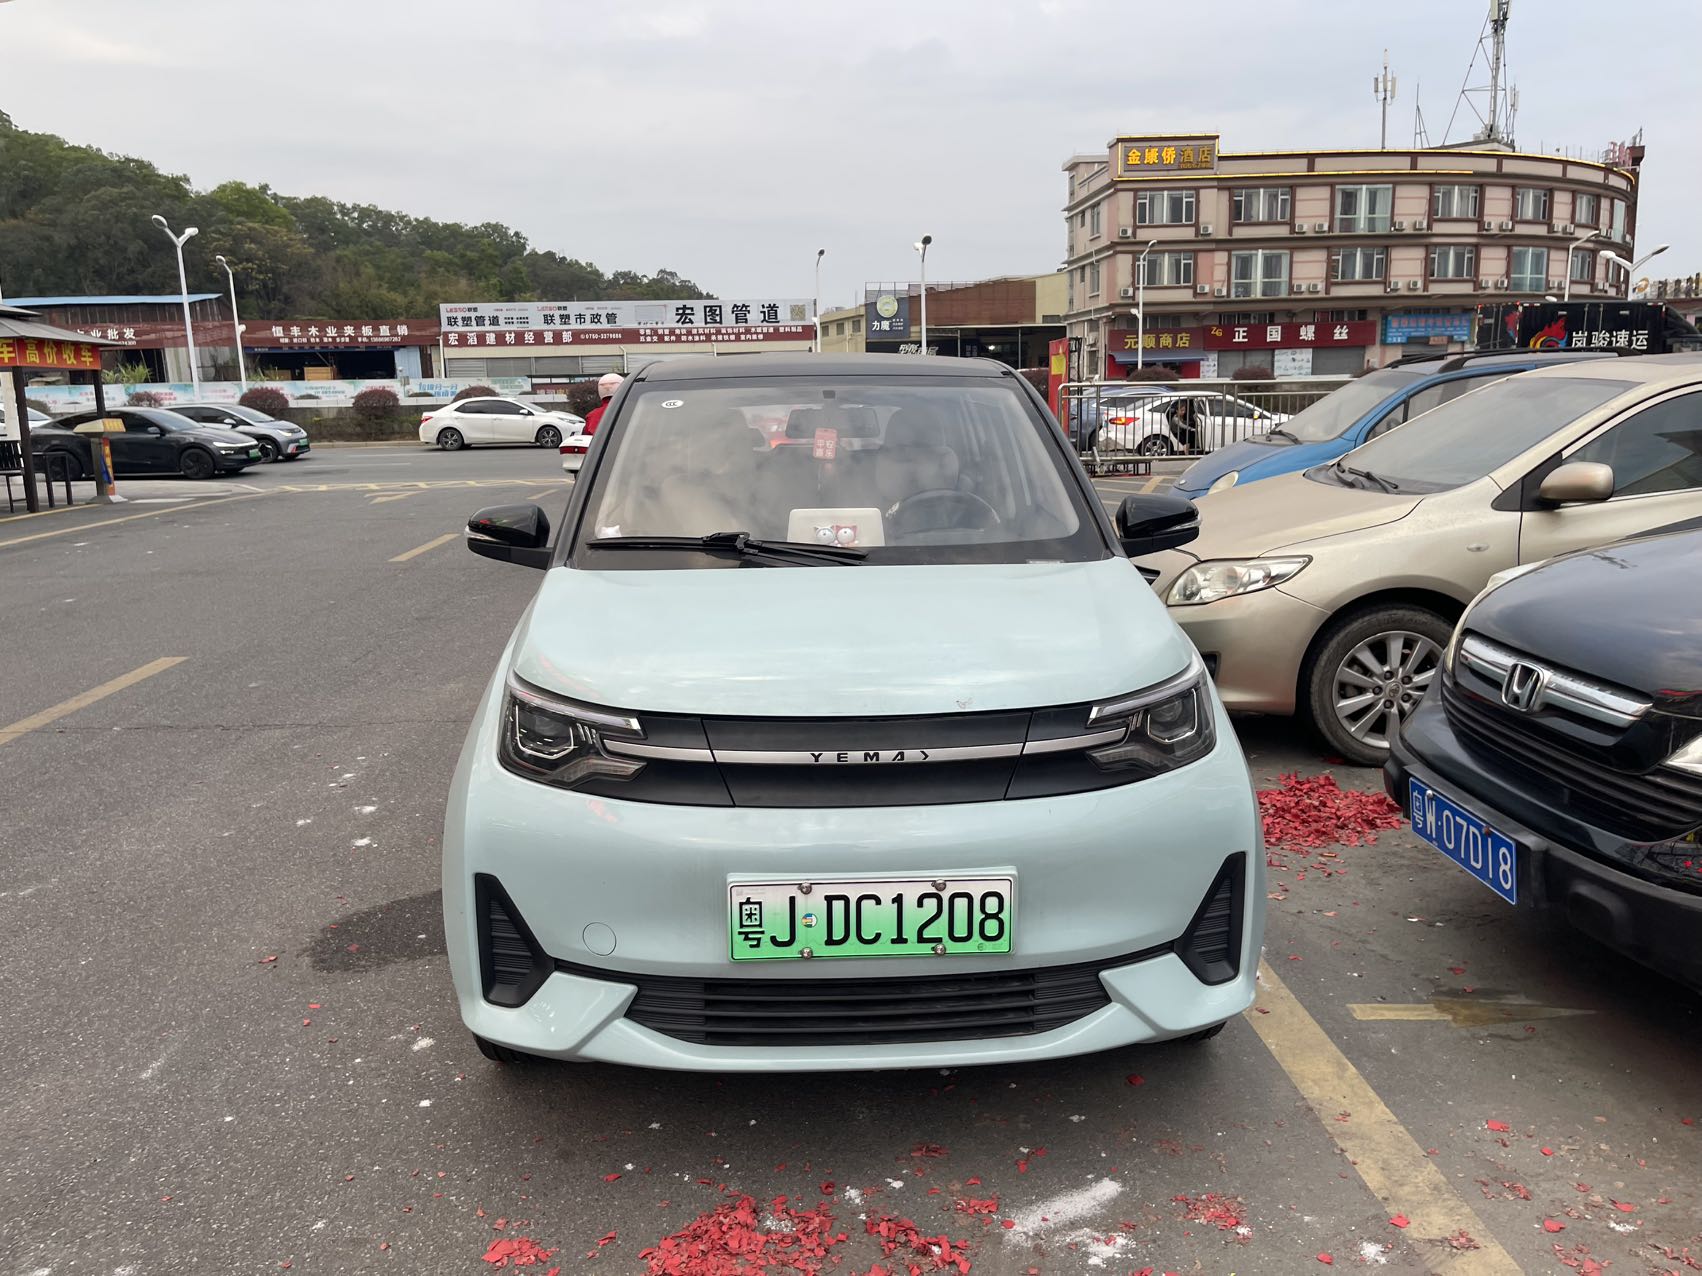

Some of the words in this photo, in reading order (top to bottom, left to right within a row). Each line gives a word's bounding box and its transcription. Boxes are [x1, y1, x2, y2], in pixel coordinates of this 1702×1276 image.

[446, 315, 501, 327] 联塑管道
[543, 312, 618, 326] 联塑市政管
[675, 304, 780, 326] 宏图管道
[271, 324, 409, 337] 恒丰木业夹板直销
[1232, 324, 1349, 342] 正国螺丝
[448, 331, 573, 345] 宏滔建材经营部
[1571, 329, 1649, 350] 岚骏速运
[810, 751, 905, 763] YEMA
